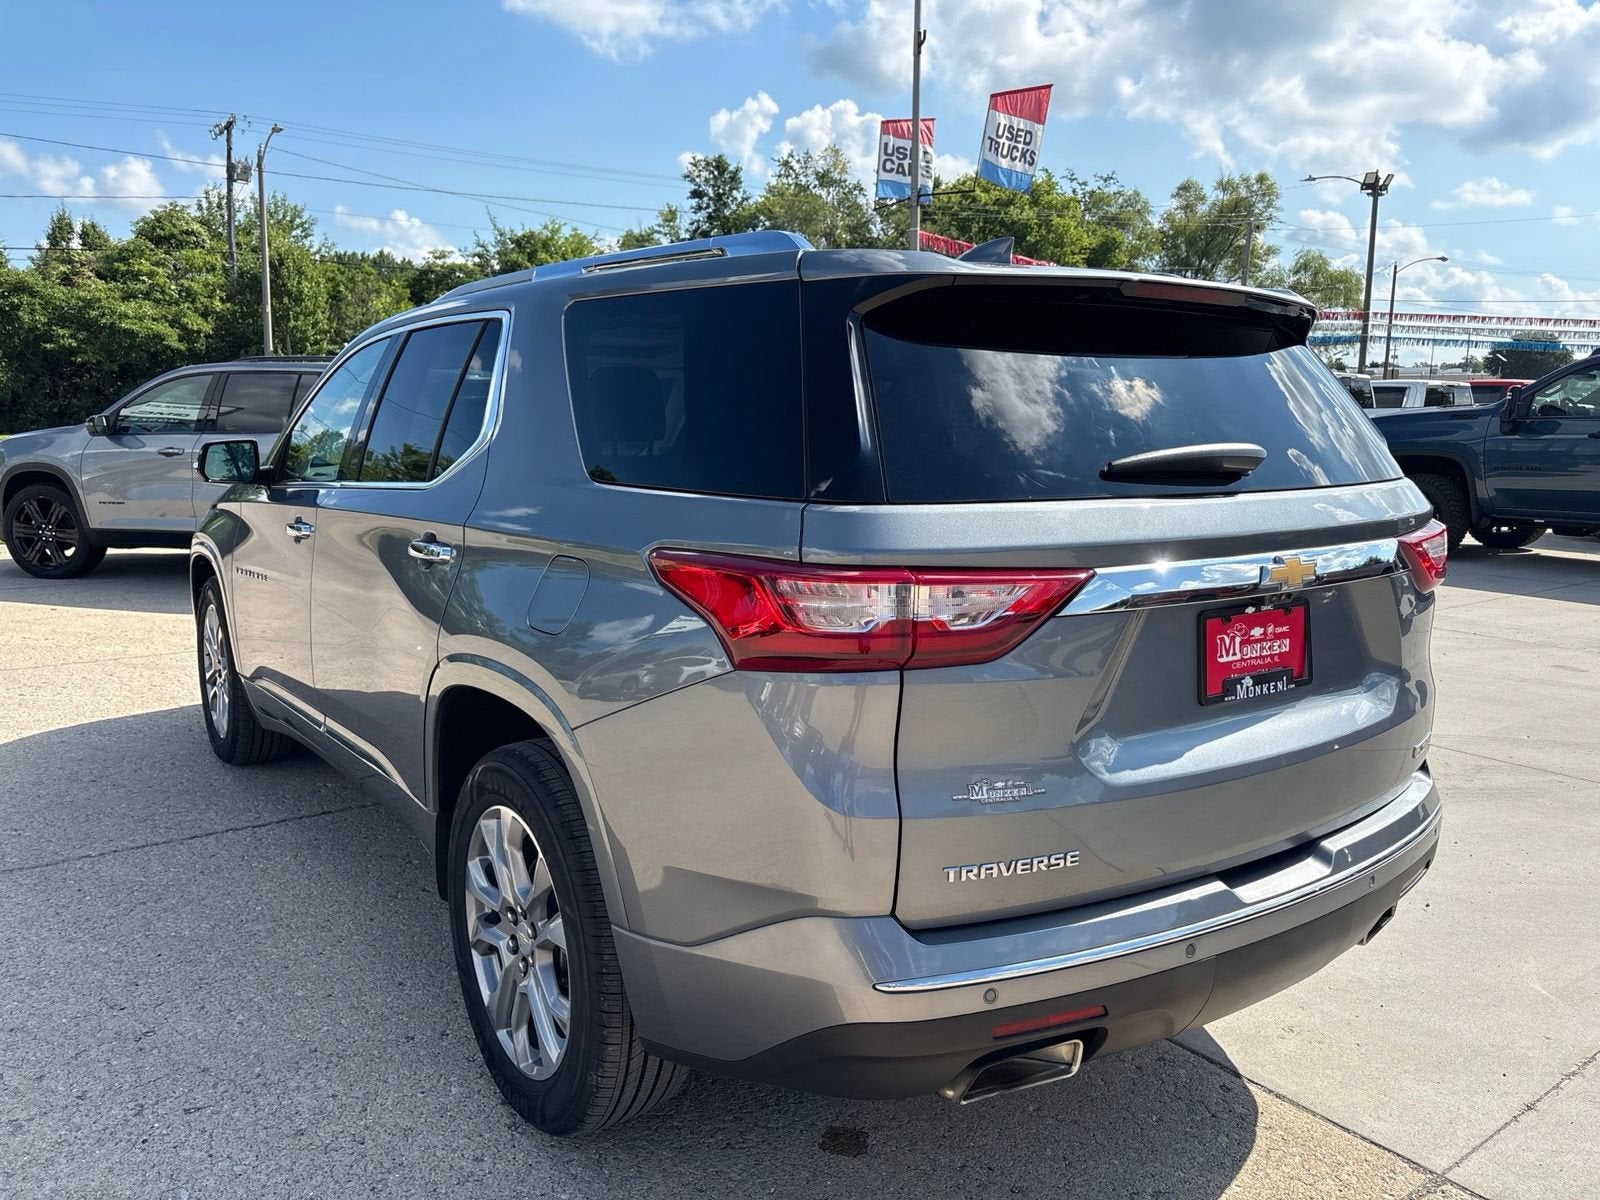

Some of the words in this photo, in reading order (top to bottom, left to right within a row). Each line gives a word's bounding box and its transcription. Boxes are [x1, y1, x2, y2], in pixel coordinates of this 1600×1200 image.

[996, 122, 1033, 147] USED
[883, 142, 934, 165] USD
[987, 136, 1037, 167] TRUCKS
[882, 158, 933, 180] CAS
[943, 850, 1080, 883] TRAVERSE
